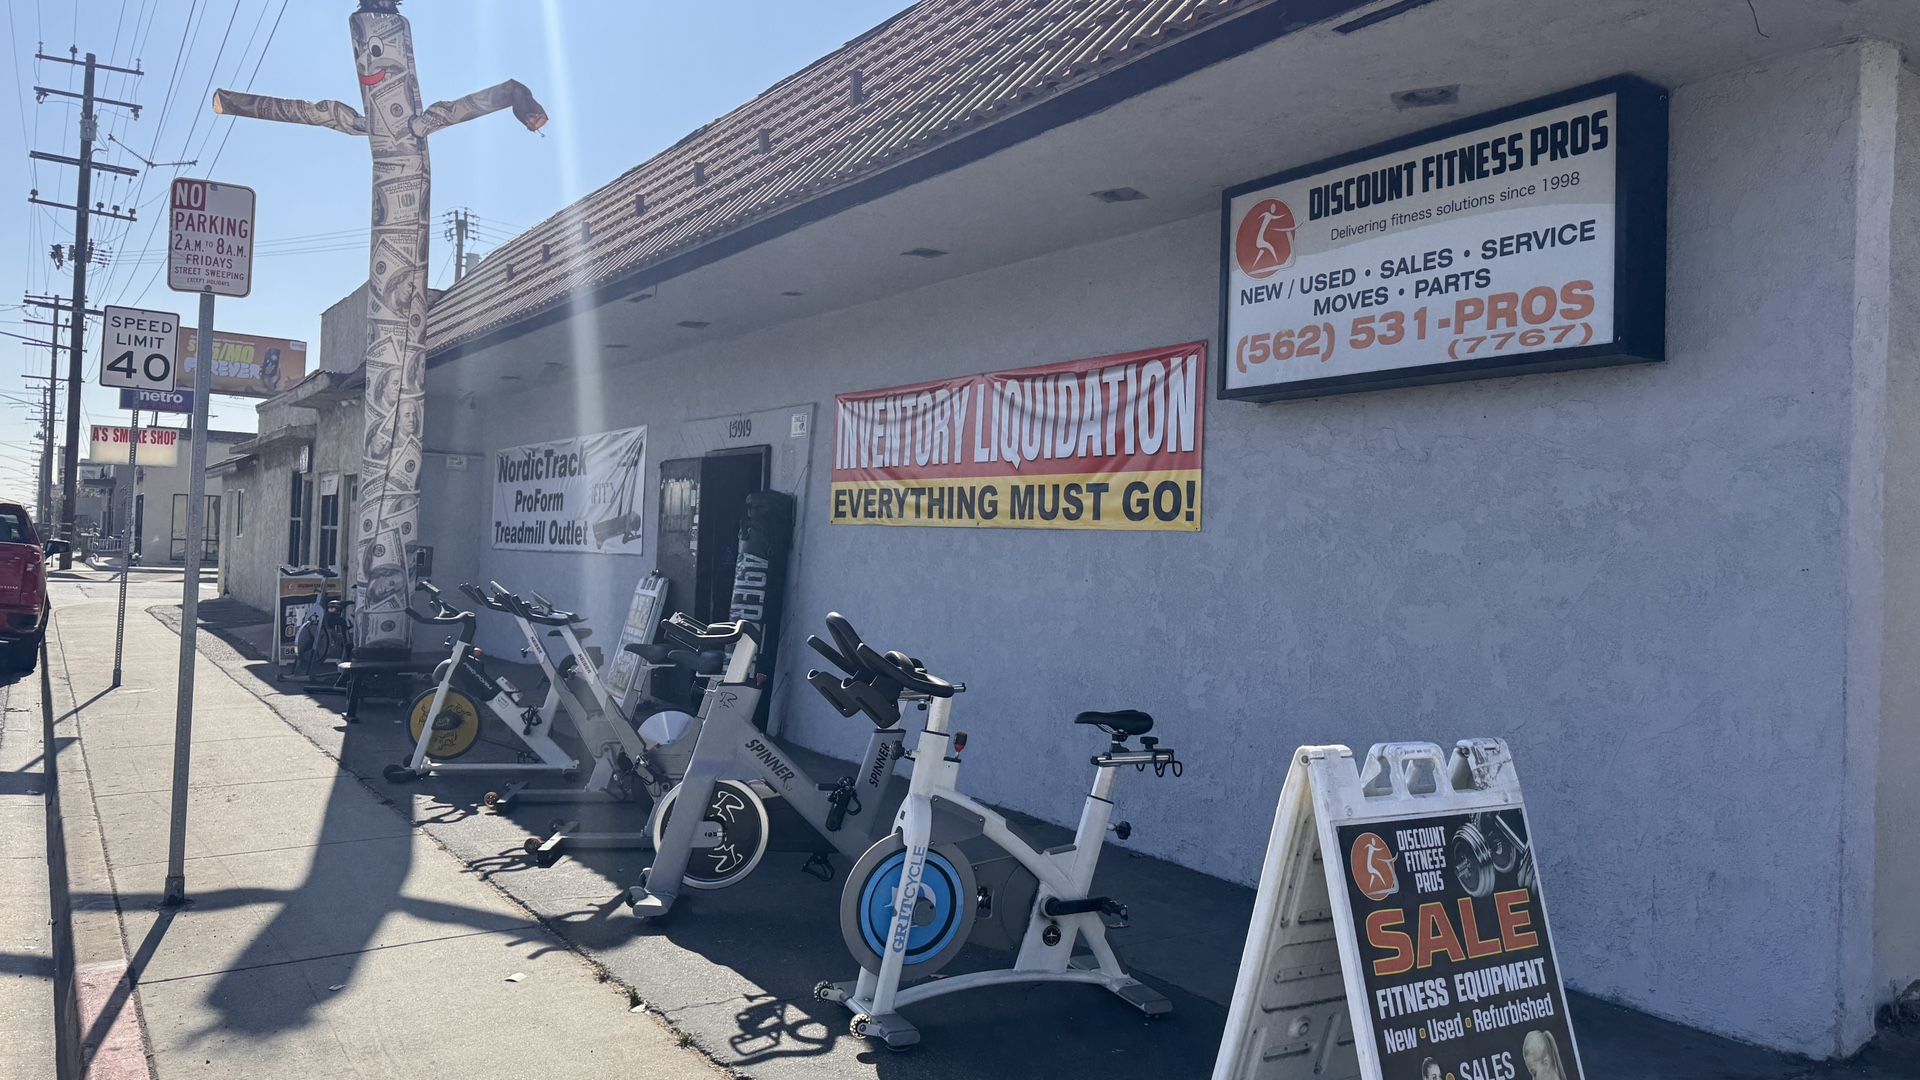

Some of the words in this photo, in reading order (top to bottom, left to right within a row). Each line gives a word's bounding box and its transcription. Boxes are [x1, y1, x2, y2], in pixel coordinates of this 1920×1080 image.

[1309, 161, 1416, 221] DISCOUNT
[1422, 132, 1524, 193] FITNESS
[1531, 109, 1609, 167] PROS
[175, 182, 203, 208] NO
[1330, 215, 1388, 242] Delivering
[1390, 207, 1433, 228] fitness
[1436, 193, 1495, 217] solutions
[1499, 183, 1537, 204] since
[1541, 171, 1581, 194] 1998
[175, 211, 248, 239] PARKING
[174, 266, 201, 276] STREET
[205, 268, 245, 281] SWEEPING
[185, 254, 233, 269] FRIDAYS
[1240, 281, 1284, 307] NEW
[1299, 267, 1356, 295] USED
[1380, 248, 1453, 279] SALES
[1480, 219, 1597, 260] SERVICE
[1313, 286, 1389, 316] MOVES
[1415, 267, 1491, 299] PARTS
[110, 315, 173, 334] SPEED
[1235, 322, 1336, 374] (562)
[1349, 279, 1595, 350] 531-PROS
[116, 332, 165, 349] LIMIT
[1447, 322, 1594, 360] (7767)
[106, 350, 171, 382] 40
[183, 356, 261, 380] FREVER
[835, 384, 971, 470] INVENTORY
[973, 354, 1198, 470] LIQUIDATION
[92, 427, 109, 442] A'S
[150, 430, 177, 446] SHOP
[729, 419, 752, 438] 15919
[498, 445, 588, 483] NordicTrack
[514, 488, 564, 513] ProForm
[834, 485, 999, 520] EVERYTHING
[1009, 482, 1110, 521] MUST
[1121, 480, 1196, 522] GO!
[495, 521, 546, 545] Treadmill
[549, 519, 589, 546] Outlet
[745, 738, 796, 785] SPINNER
[868, 742, 890, 788] SPINNER
[1396, 826, 1447, 851] DISCOUNT
[1404, 848, 1447, 873] FITNESS
[1415, 870, 1445, 894] PROS
[1365, 887, 1539, 977] SALE
[1375, 977, 1450, 1020] FITNESS
[1453, 957, 1547, 1003] EQUIPMENT
[1384, 1027, 1418, 1054] New
[1427, 1012, 1465, 1043] Used
[1472, 992, 1555, 1033] Refurbished
[1459, 1051, 1516, 1080] SALES
